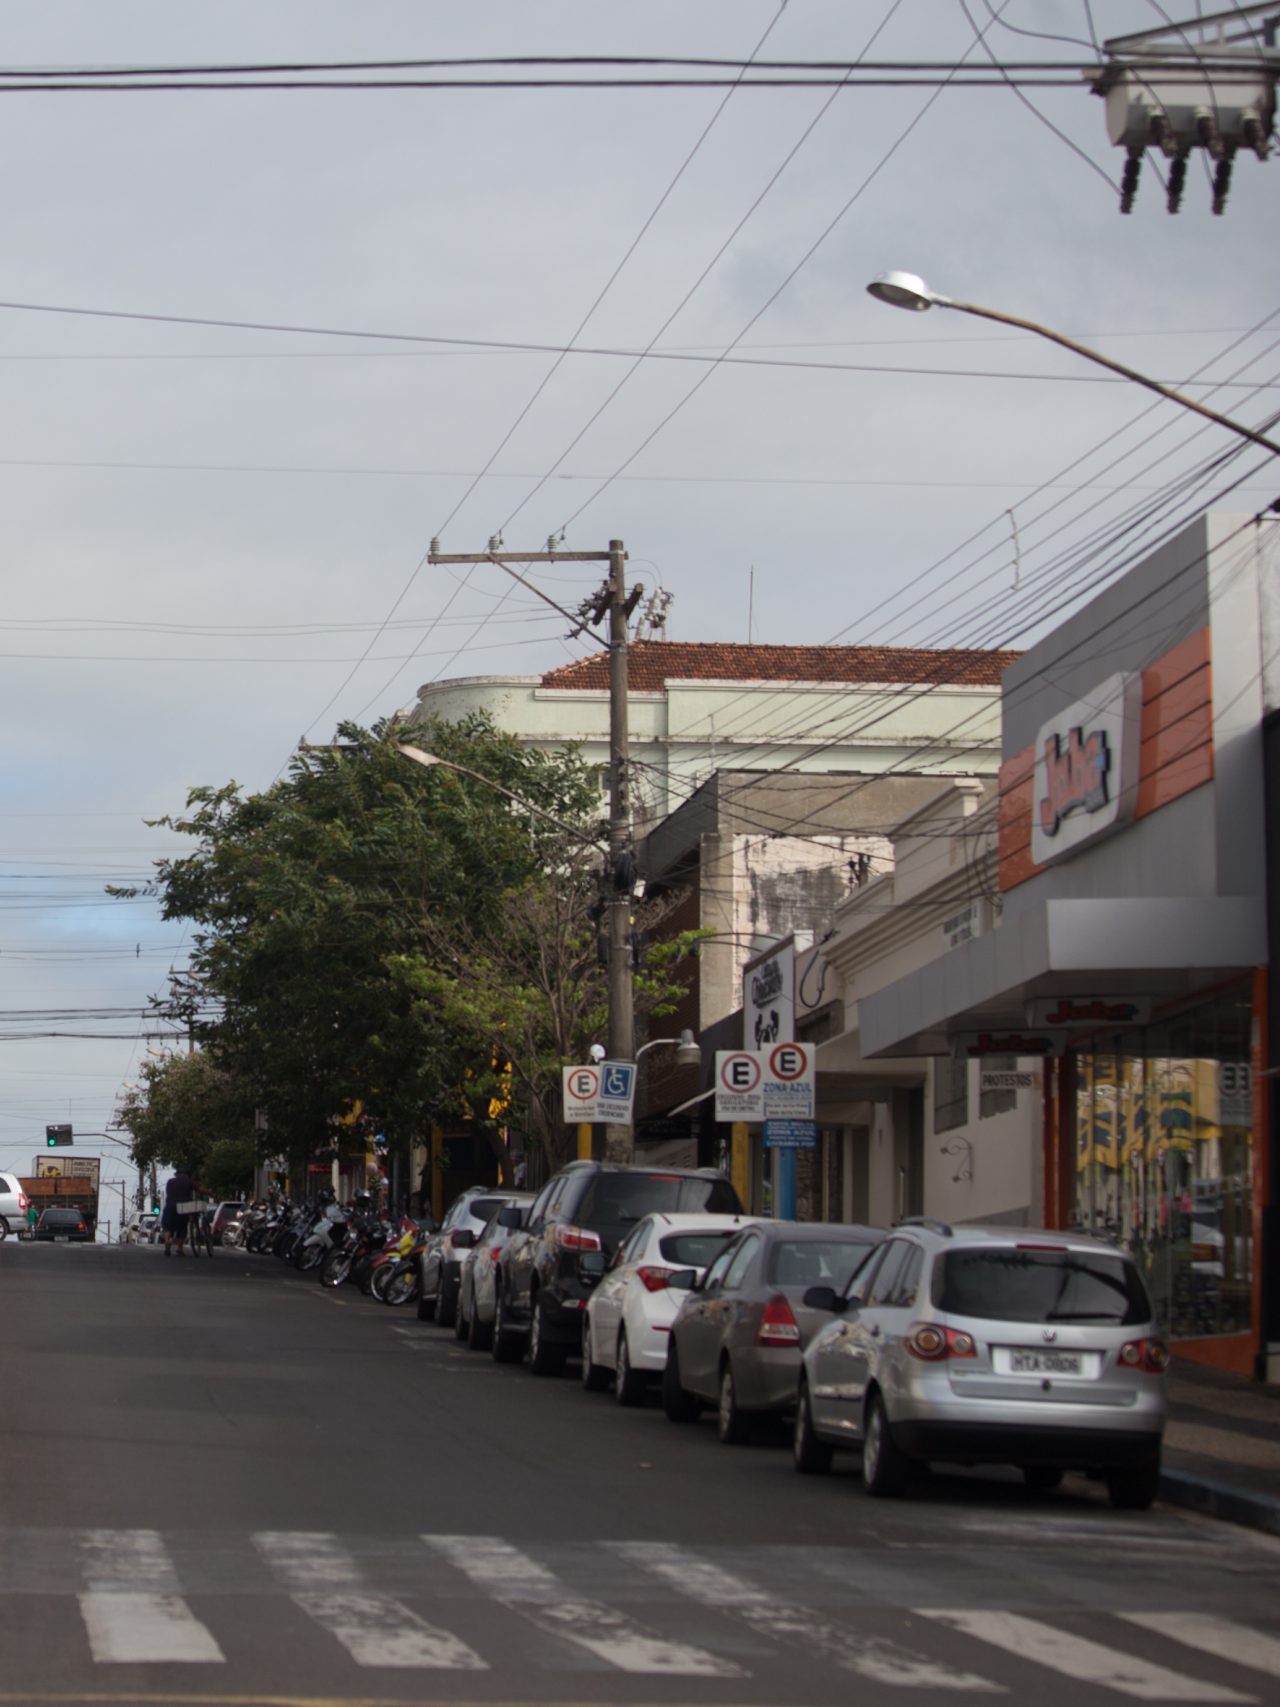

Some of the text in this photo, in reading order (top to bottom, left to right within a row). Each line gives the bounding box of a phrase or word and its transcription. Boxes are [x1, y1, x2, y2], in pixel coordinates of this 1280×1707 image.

[780, 1051, 796, 1073] E
[732, 1061, 749, 1086] E
[983, 1073, 1032, 1087] PROTESTOS
[577, 1074, 590, 1093] E
[763, 1082, 812, 1093] ZONA AZUL
